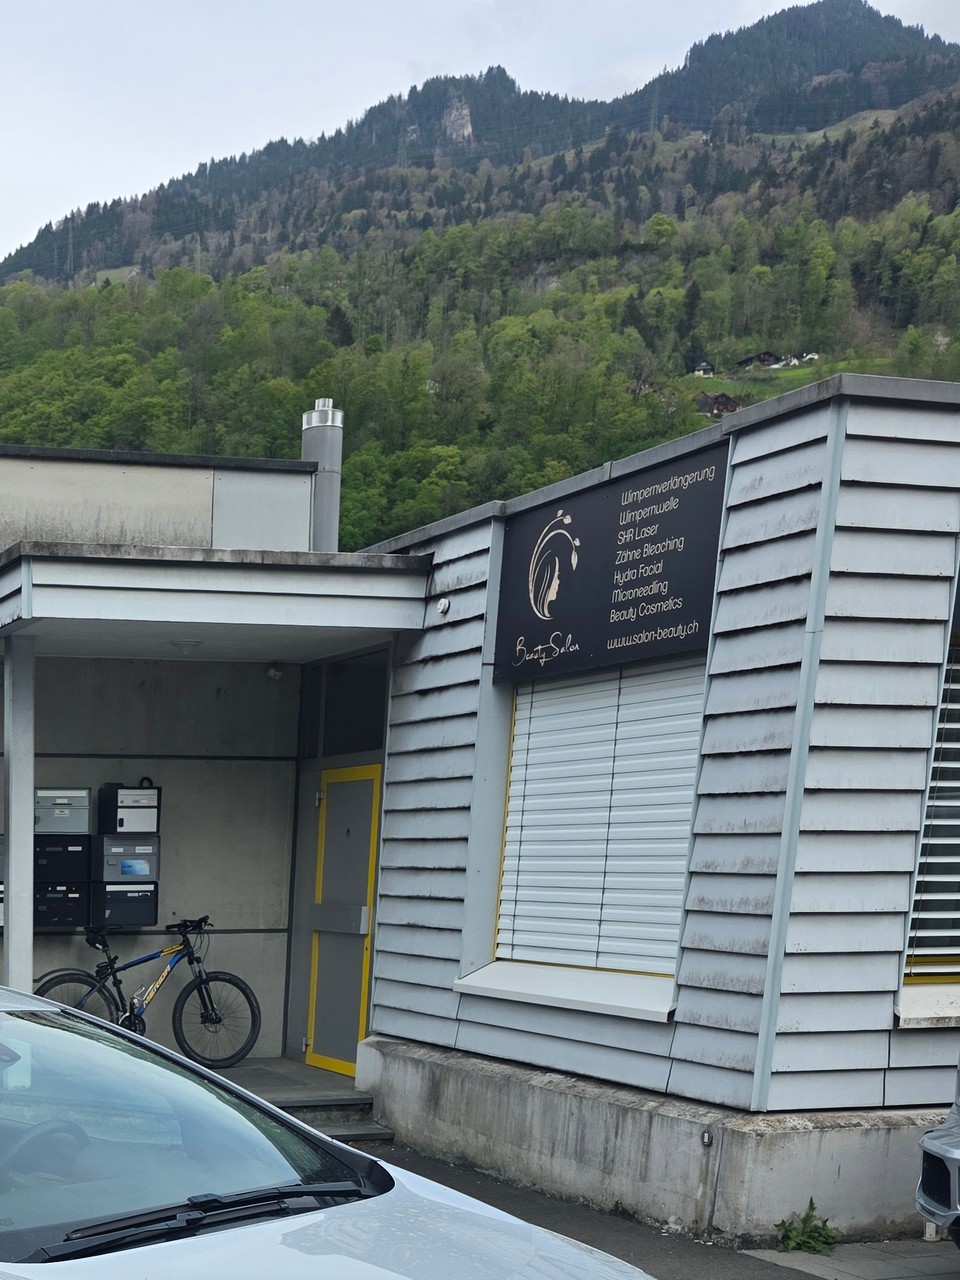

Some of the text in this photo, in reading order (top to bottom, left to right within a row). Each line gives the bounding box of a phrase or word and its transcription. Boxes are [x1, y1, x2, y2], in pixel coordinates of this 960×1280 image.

[621, 464, 716, 506] Wimpernverlängerung
[619, 496, 680, 526] Wimpernwelle
[617, 523, 660, 546] SHR Laser
[615, 536, 685, 565] Zähne Bleaching
[613, 559, 664, 587] Hydro Facial
[611, 579, 669, 604] Microneedling
[609, 596, 683, 624] Beauty Cosmetics
[512, 631, 580, 667] Beauty Salon
[607, 620, 699, 650] www.salon-beauty.ch
